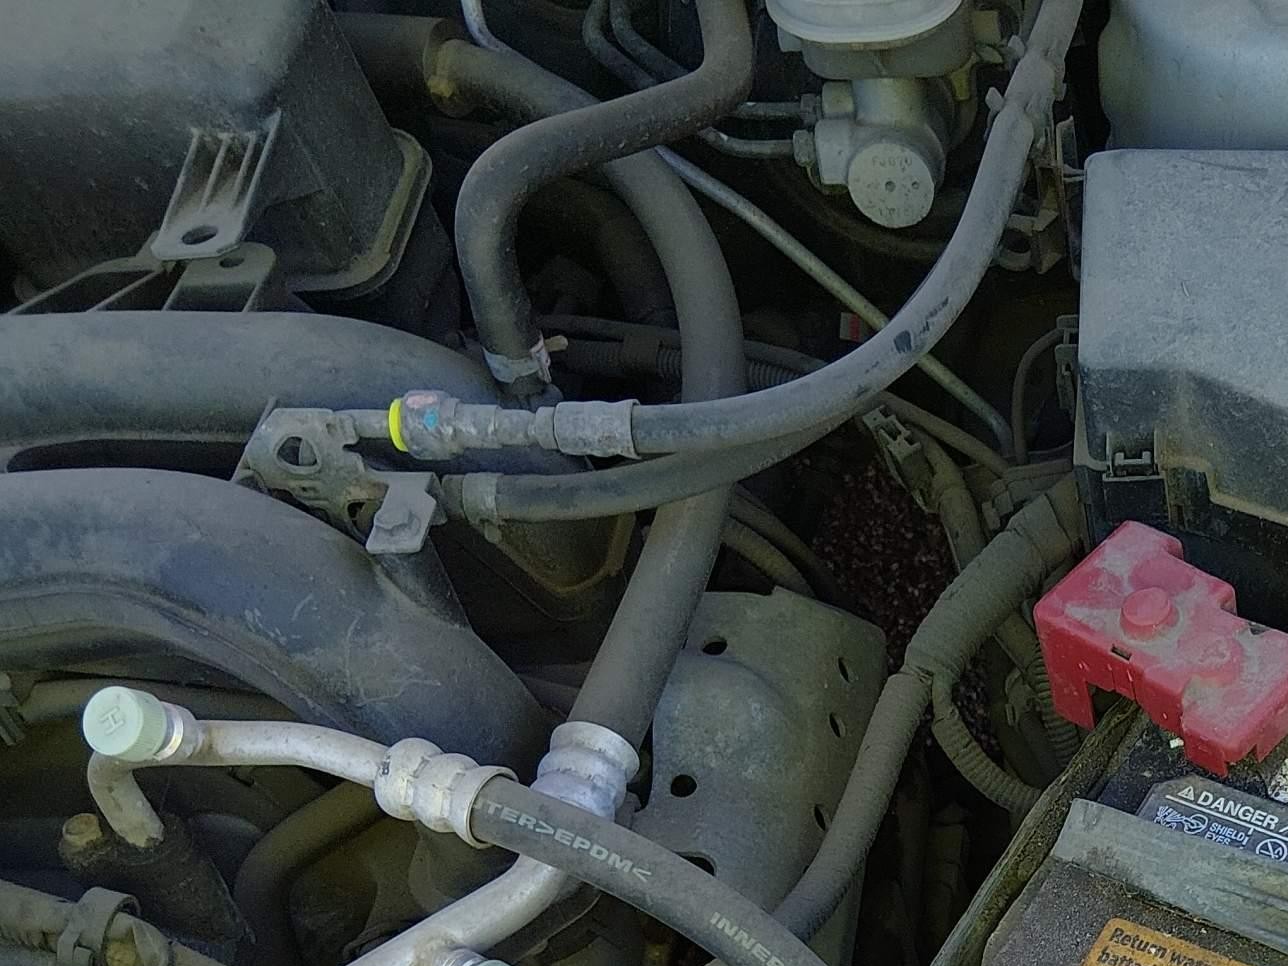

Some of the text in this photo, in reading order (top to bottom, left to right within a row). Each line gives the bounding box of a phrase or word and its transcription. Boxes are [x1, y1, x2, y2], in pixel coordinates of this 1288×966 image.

[1197, 791, 1279, 831] DANGER
[1208, 822, 1246, 844] SHIELD
[1109, 927, 1166, 959] Return
